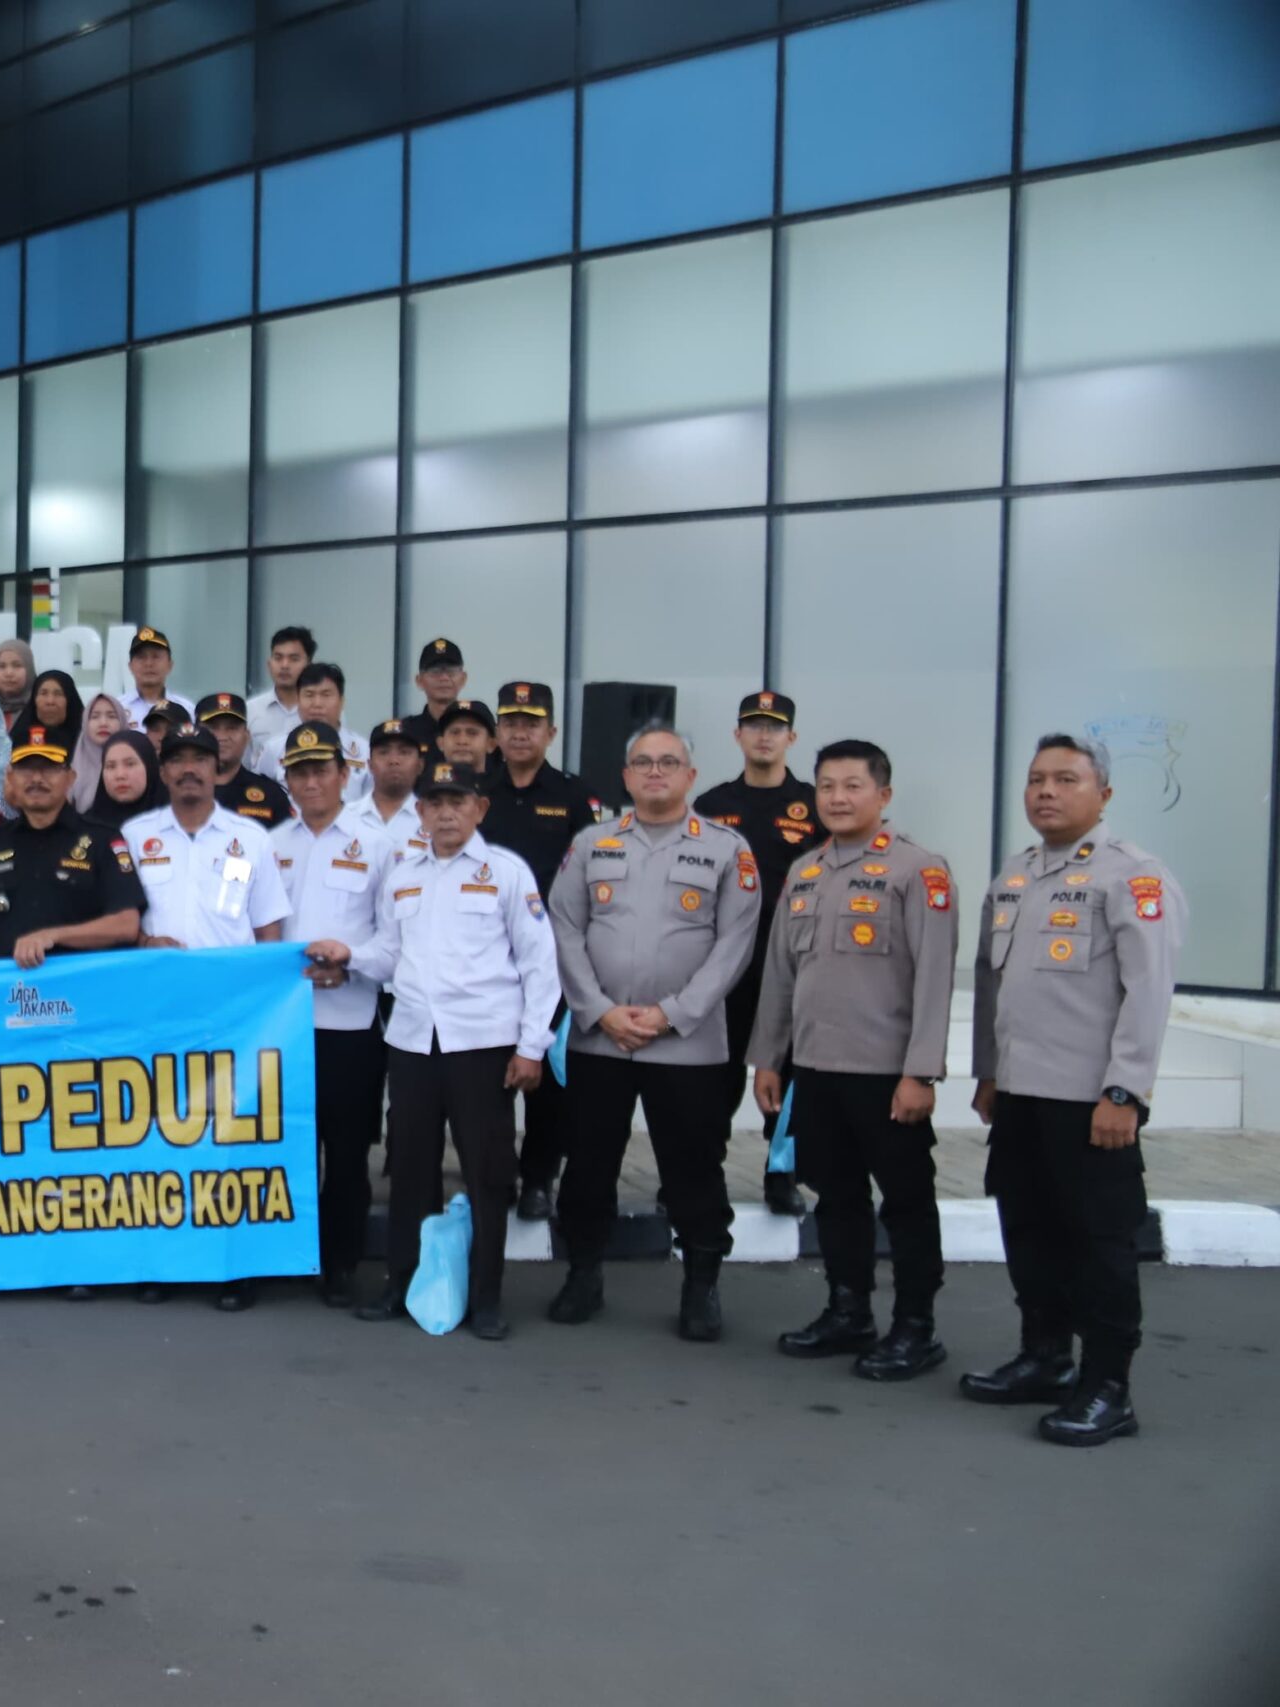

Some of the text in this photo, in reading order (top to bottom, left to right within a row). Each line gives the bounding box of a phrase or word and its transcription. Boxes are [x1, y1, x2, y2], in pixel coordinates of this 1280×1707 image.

[677, 854, 715, 868] POLRI
[848, 879, 887, 891] POLRI
[1050, 892, 1088, 903] POLRI
[8, 986, 39, 1004] JAGA
[16, 1000, 70, 1018] JAKARTA
[190, 1166, 295, 1227] KOTA
